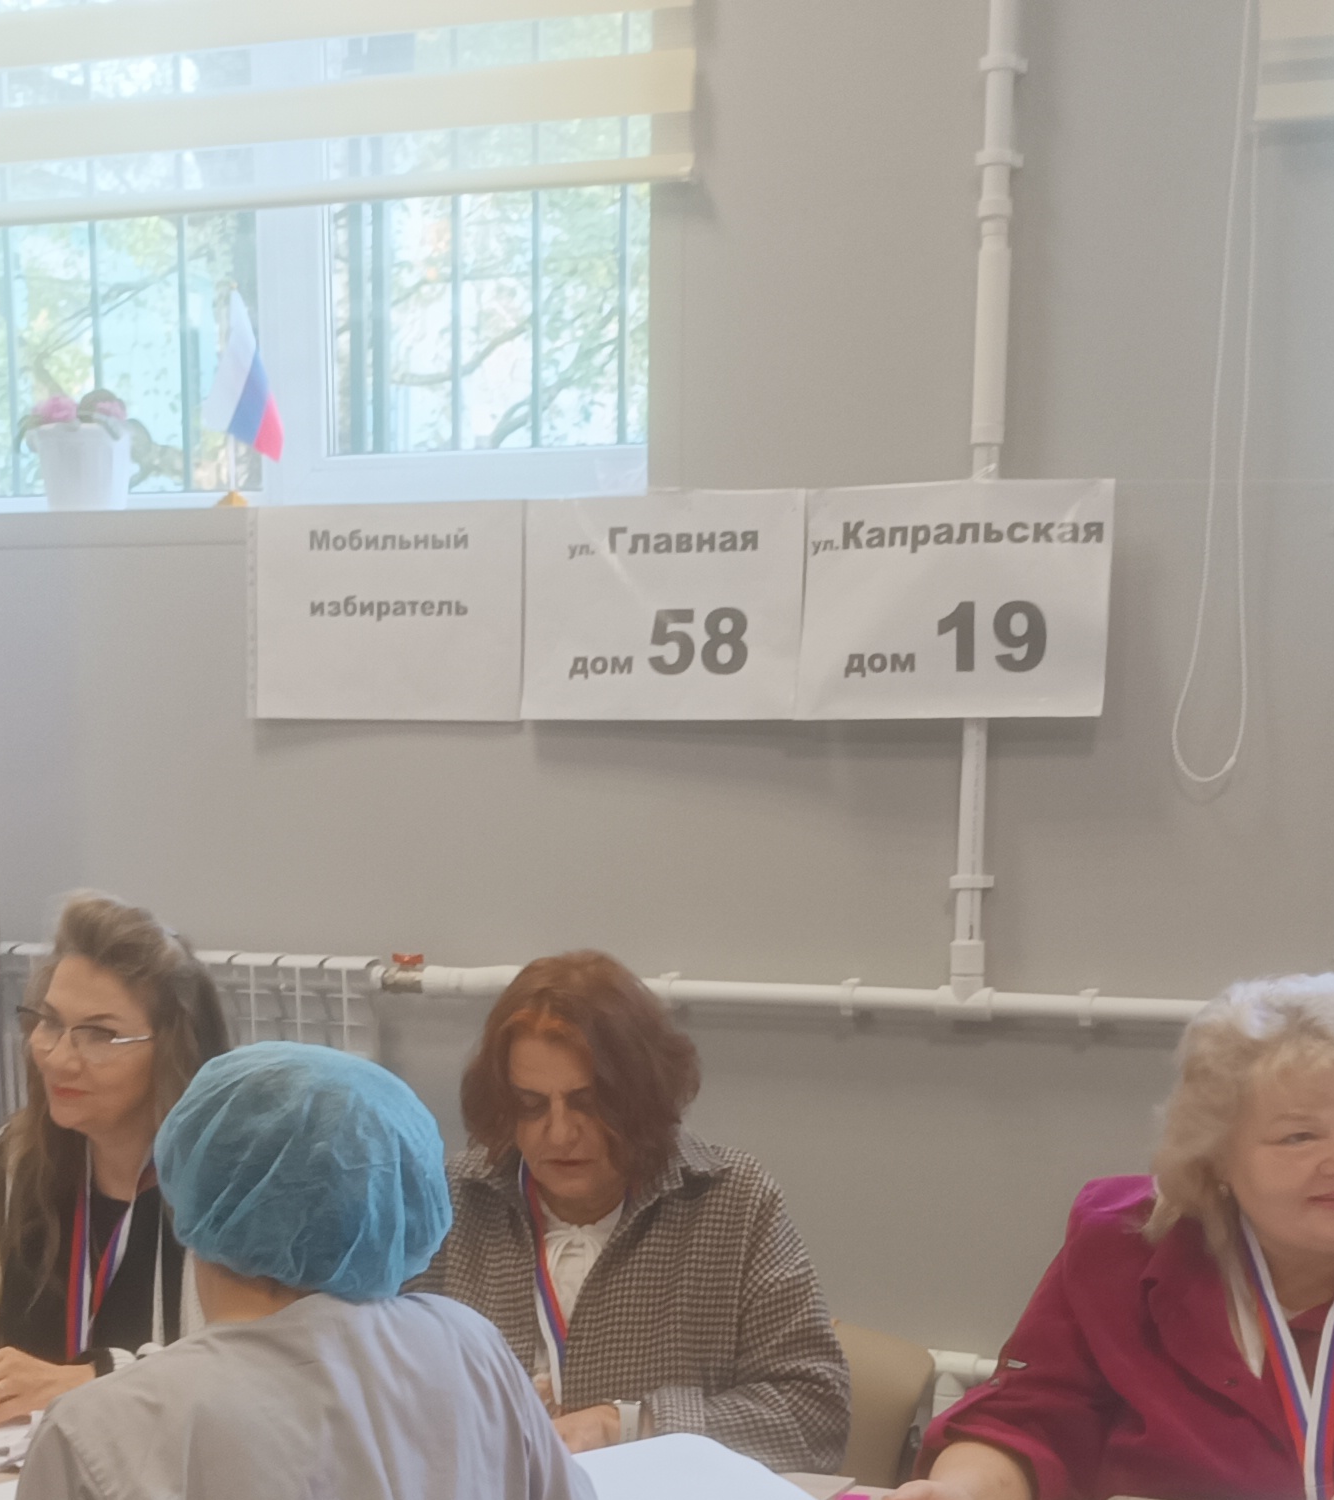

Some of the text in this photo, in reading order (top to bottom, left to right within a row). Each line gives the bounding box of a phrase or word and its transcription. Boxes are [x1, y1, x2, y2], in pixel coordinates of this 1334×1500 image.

[308, 527, 469, 552] Мобильный
[566, 526, 759, 561] ул. Главная
[308, 594, 469, 622] избиратель
[568, 606, 749, 681] дом 58
[842, 600, 1048, 680] дом 19
